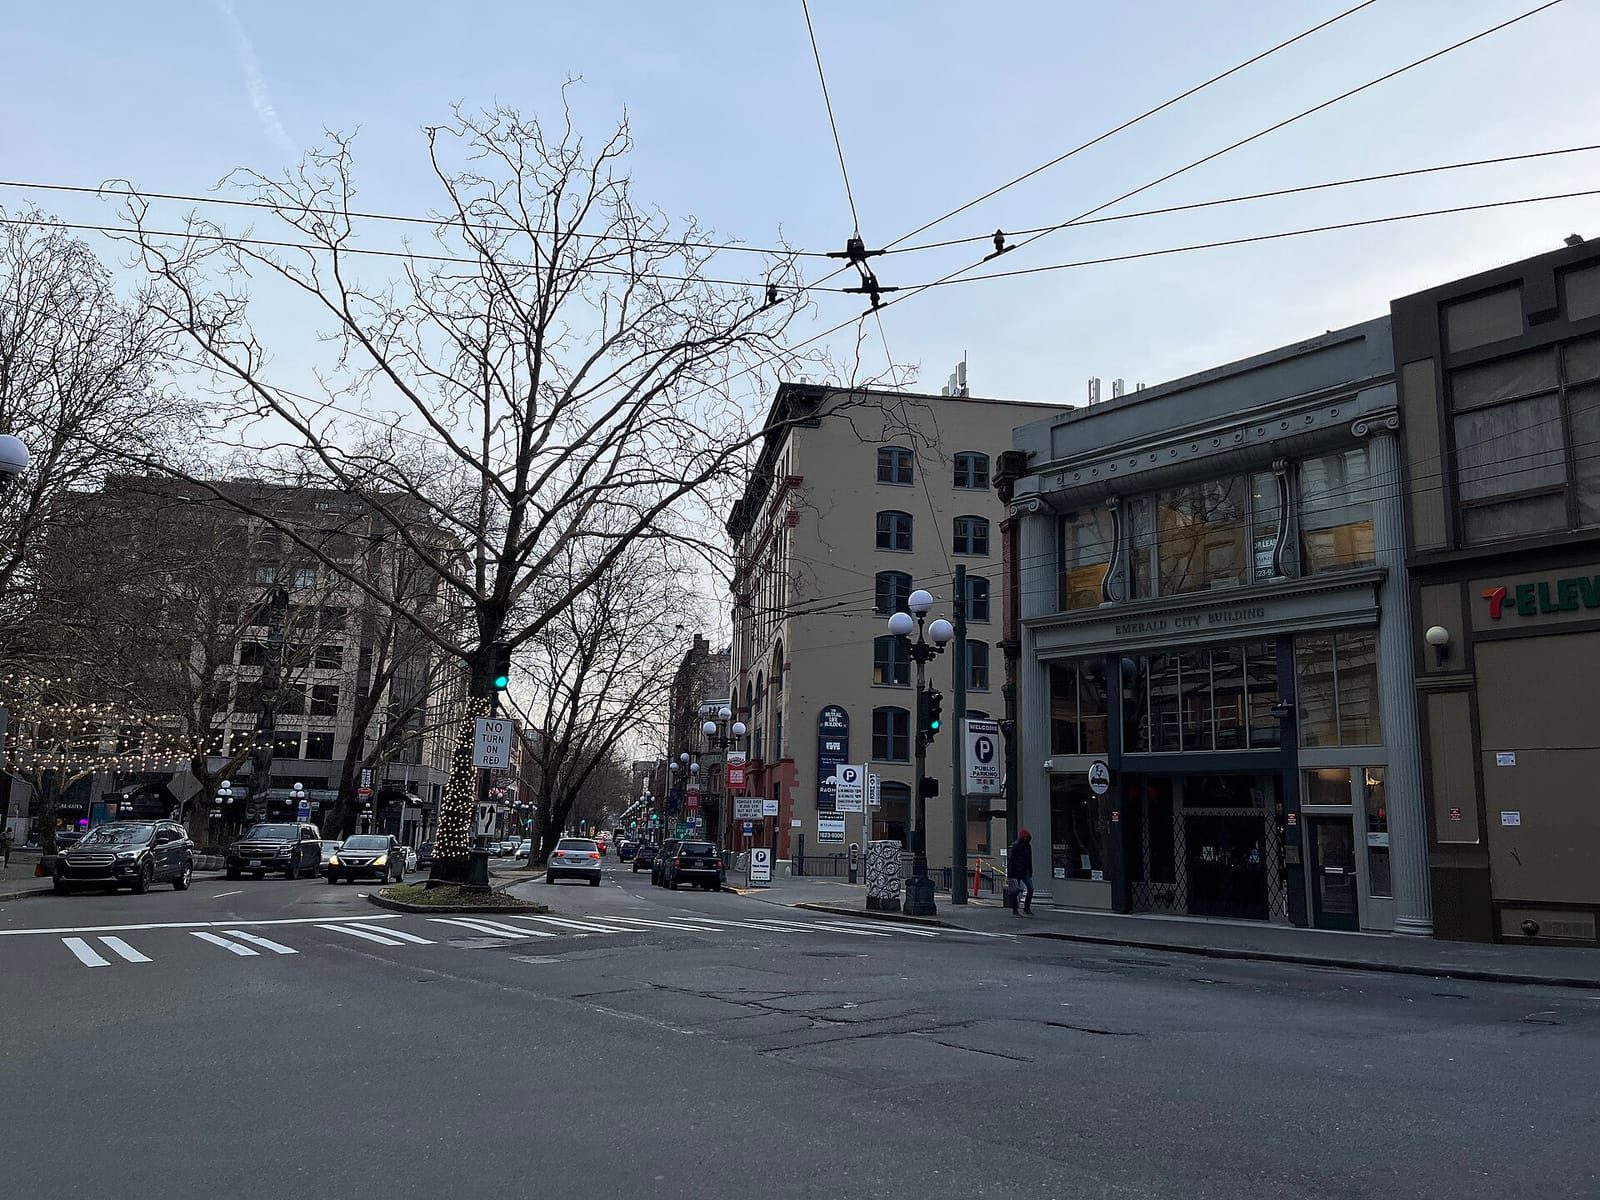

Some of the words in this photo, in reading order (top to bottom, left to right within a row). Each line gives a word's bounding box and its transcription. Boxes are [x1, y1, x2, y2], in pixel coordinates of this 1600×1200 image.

[1115, 621, 1167, 635] EMERALD
[1174, 615, 1201, 629] CITY
[1208, 607, 1265, 625] BUILDING
[486, 721, 503, 733] NO
[969, 724, 998, 732] WELCOME
[482, 734, 504, 744] TURN
[486, 745, 498, 754] ON
[980, 740, 990, 760] P
[483, 755, 500, 765] RED
[846, 770, 855, 781] P
